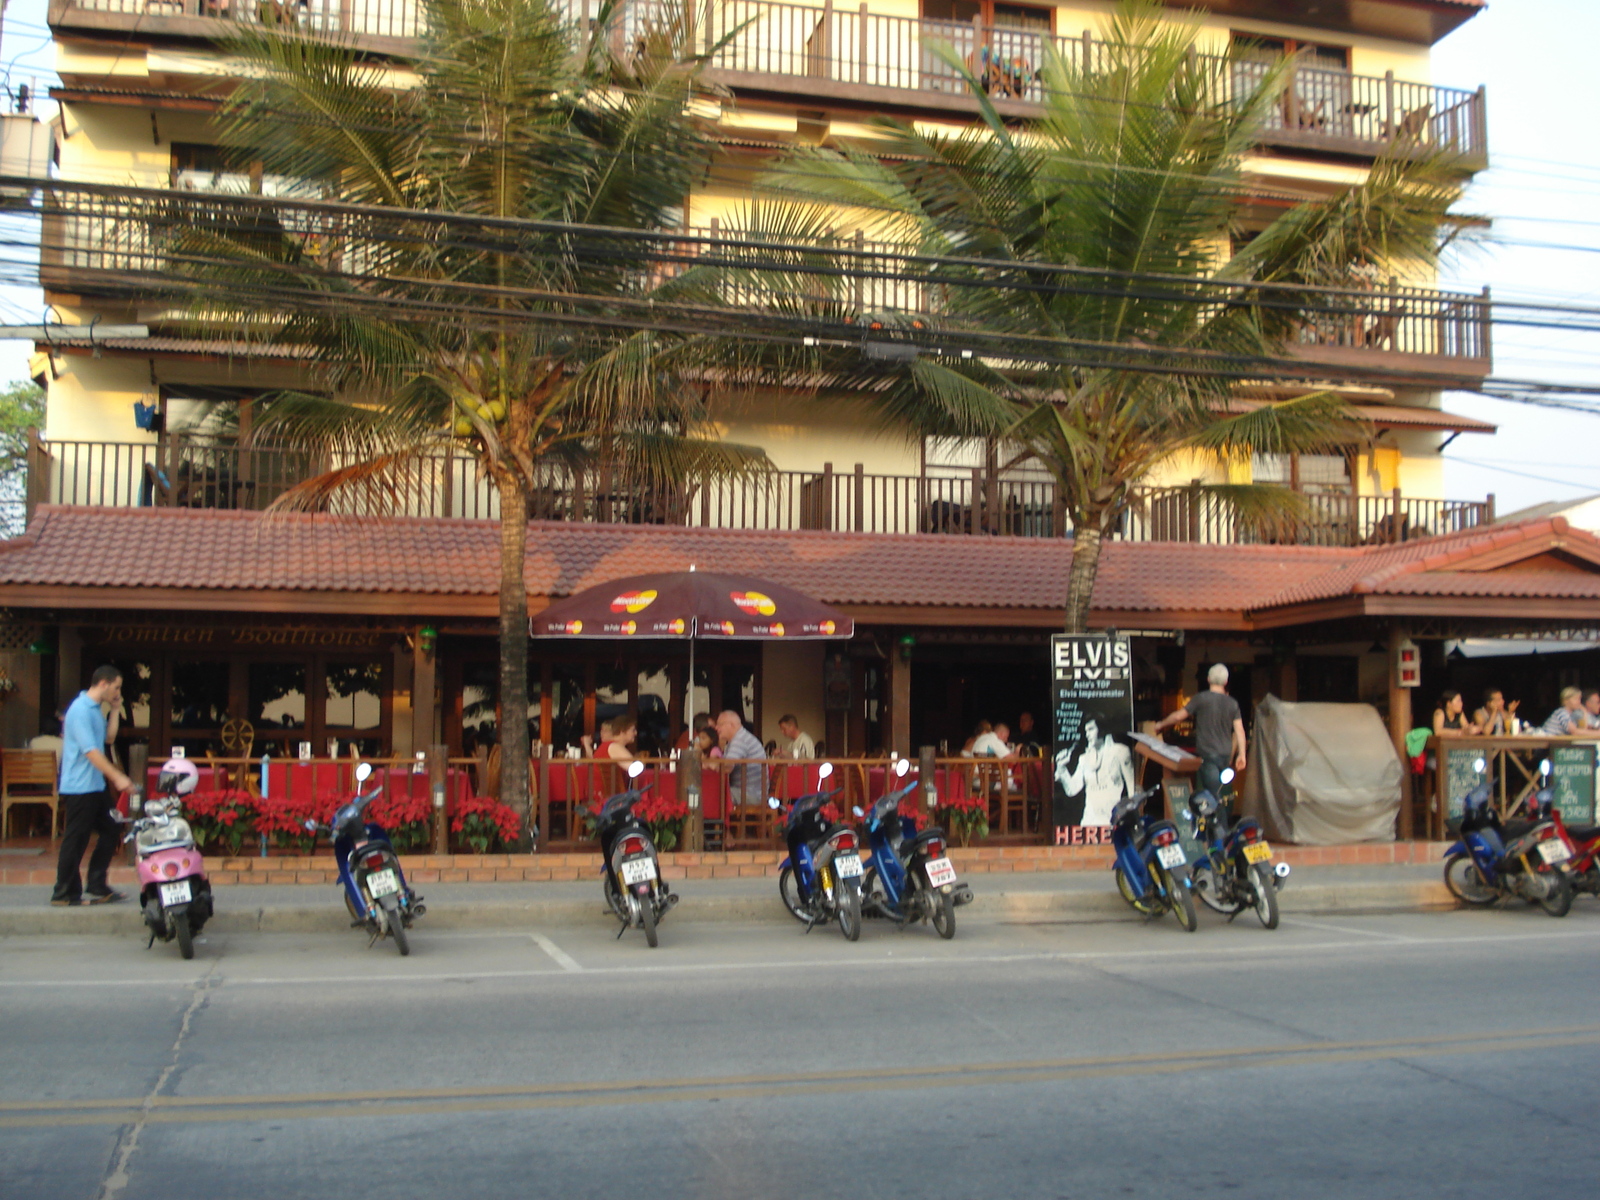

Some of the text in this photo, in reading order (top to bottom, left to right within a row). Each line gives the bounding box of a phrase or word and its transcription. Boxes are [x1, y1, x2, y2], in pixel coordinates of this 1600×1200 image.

[1055, 641, 1129, 667] ELVIS
[1055, 667, 1130, 680] LIVE!
[1060, 689, 1078, 698] Elvis
[1061, 701, 1078, 711] Every
[1056, 709, 1083, 719] Thursday
[1063, 718, 1081, 727] Friday
